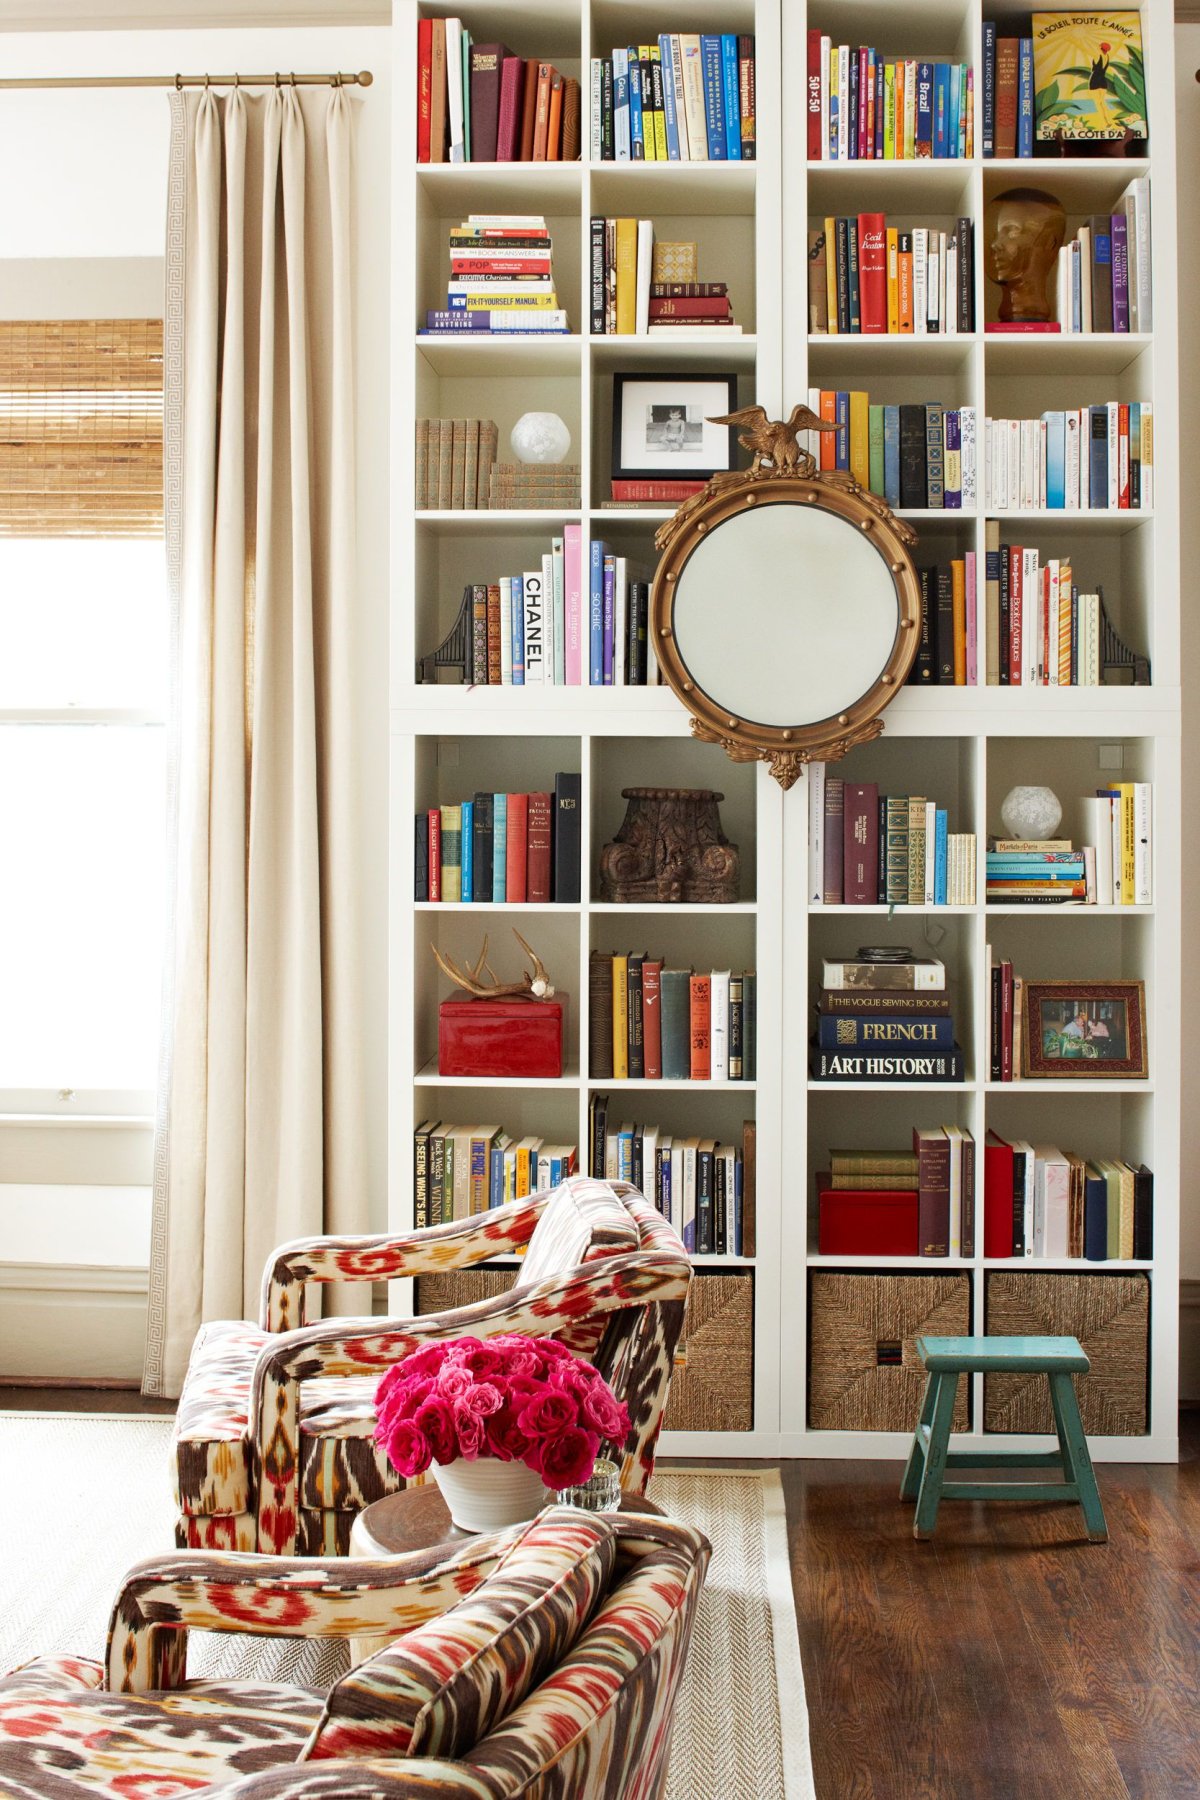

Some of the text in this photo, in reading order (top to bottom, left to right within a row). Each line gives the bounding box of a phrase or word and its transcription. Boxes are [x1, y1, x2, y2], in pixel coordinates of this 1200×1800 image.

[1045, 20, 1071, 33] SOLEIL
[653, 65, 662, 107] Economics
[740, 60, 749, 117] Thermodynamics
[920, 82, 930, 112] Brazil
[986, 92, 991, 101] OF
[1042, 131, 1056, 139] SU
[862, 241, 885, 249] Beaton
[865, 232, 882, 241] Cecil
[594, 234, 602, 310] THE INNOVATOR'S SOLUTION
[526, 578, 542, 670] CHANEL
[570, 592, 579, 650] Paris Interiors
[592, 593, 600, 631] SO CHIC
[1012, 627, 1020, 661] Antiques
[863, 1024, 937, 1040] FRENCH
[829, 1056, 935, 1074] ART HISTORY
[417, 1145, 426, 1180] SEEING
[472, 1142, 485, 1175] THE PRIZE
[624, 1139, 632, 1176] BORN TO
[417, 1181, 426, 1208] WHAT'S
